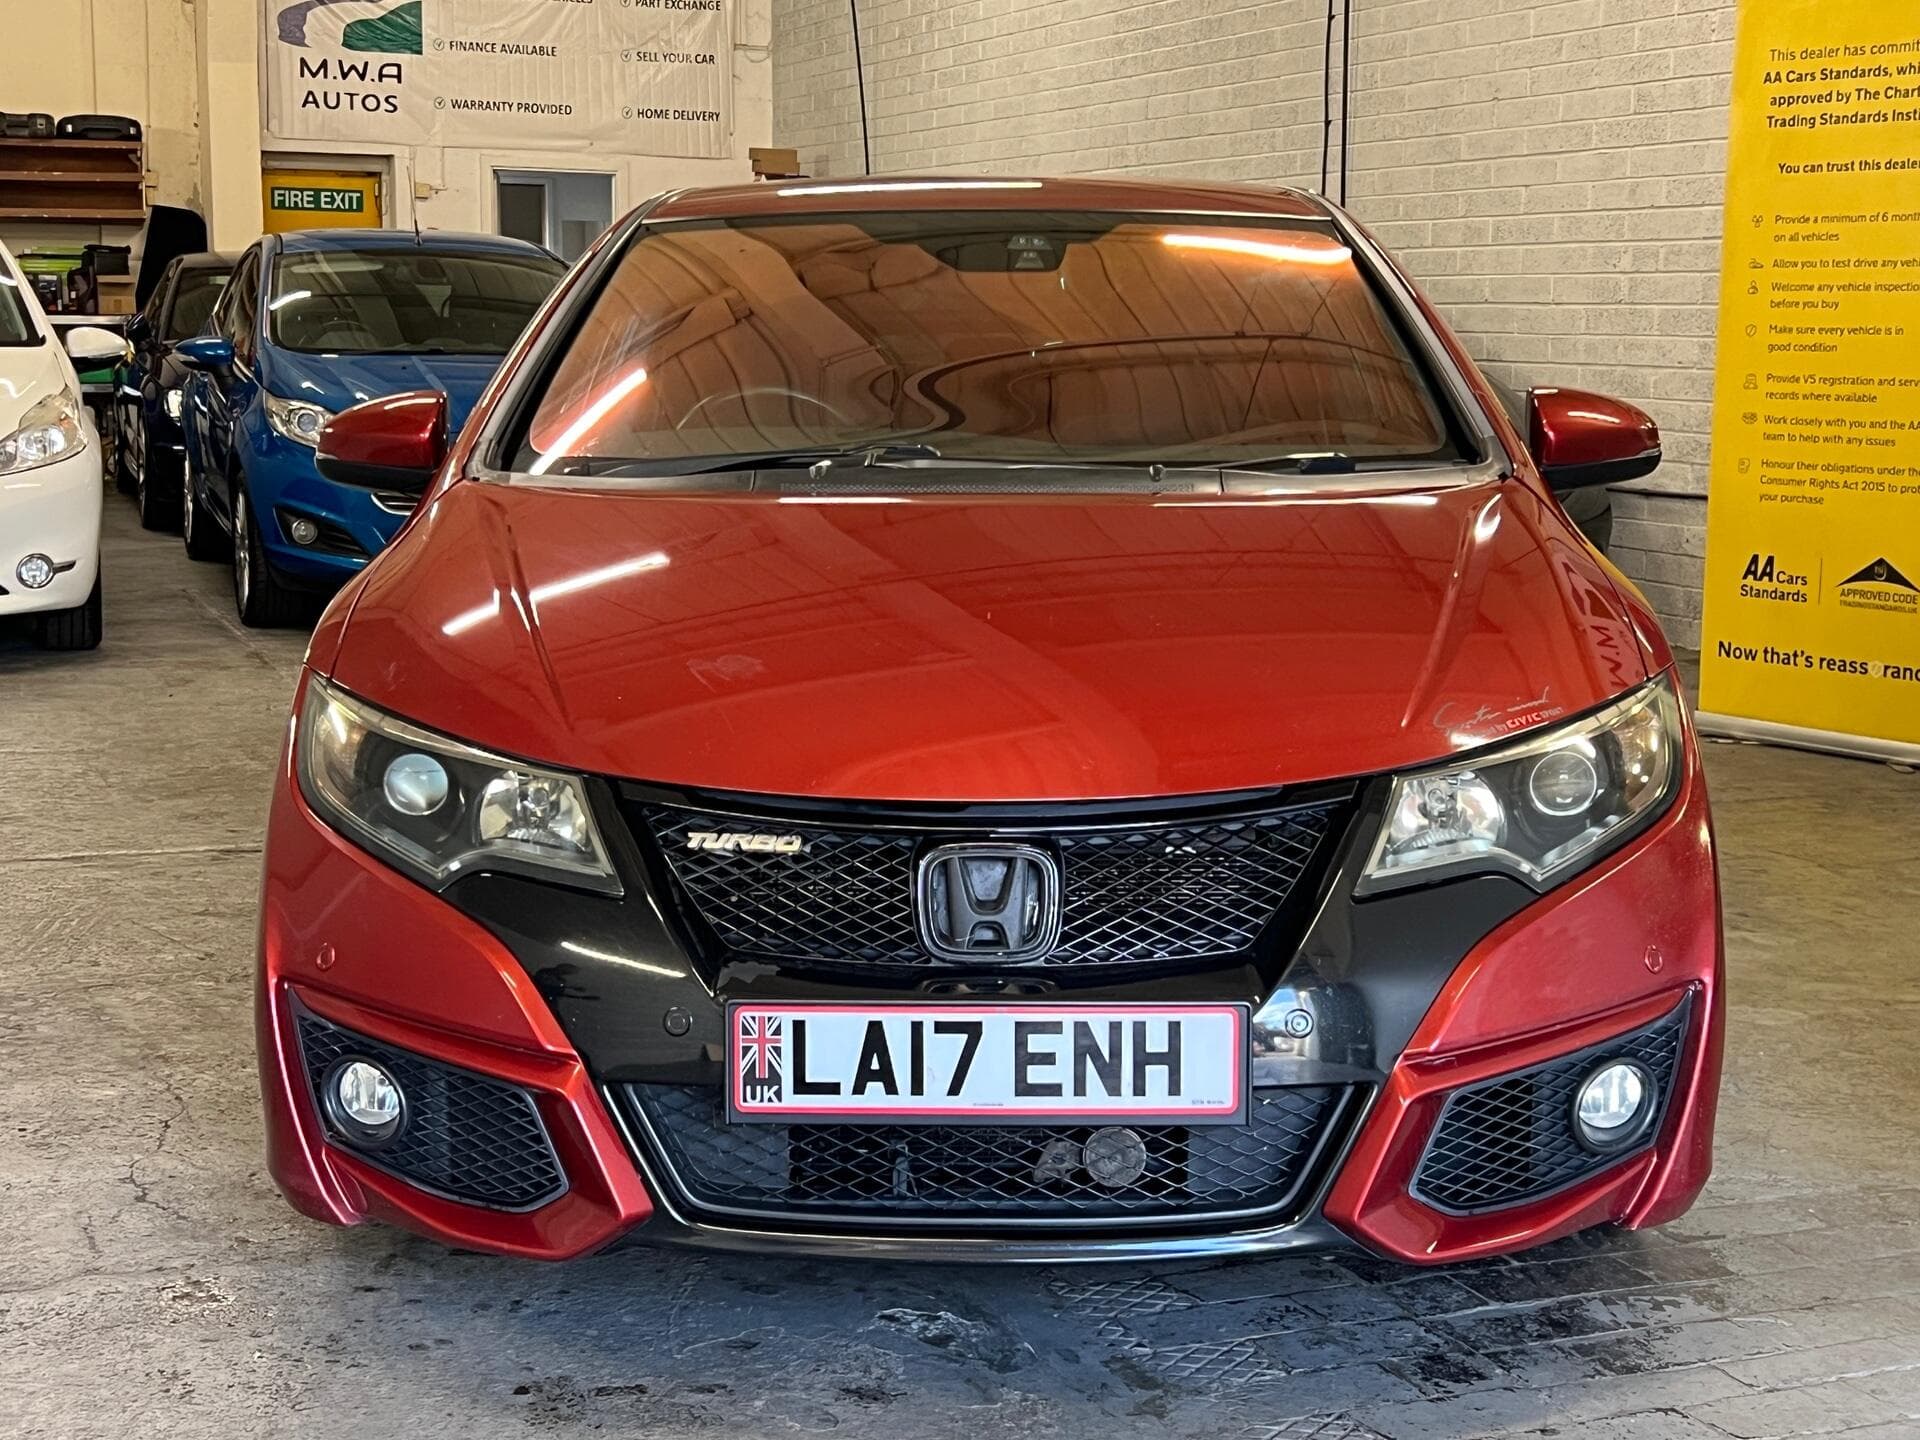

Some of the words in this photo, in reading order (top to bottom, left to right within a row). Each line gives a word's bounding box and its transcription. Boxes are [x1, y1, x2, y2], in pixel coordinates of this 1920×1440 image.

[664, 0, 721, 11] EXCHANGE
[449, 40, 497, 53] FINANCE
[500, 43, 557, 57] AVAILABLE
[1770, 48, 1796, 62] This
[1800, 45, 1840, 60] dealer
[1843, 44, 1866, 57] has
[636, 51, 660, 63] SELL
[662, 53, 693, 63] YOUR
[695, 54, 716, 65] CAR
[299, 57, 402, 84] M.W.A
[1763, 71, 1782, 85] AA
[1786, 70, 1816, 83] Cars
[1820, 64, 1893, 81] Standards,
[301, 90, 398, 113] AUTOS
[1770, 90, 1833, 108] approved
[1836, 90, 1852, 104] by
[1855, 88, 1881, 101] The
[450, 99, 514, 114] WARRANTY
[516, 102, 572, 116] PROVIDED
[636, 108, 670, 120] HOME
[673, 110, 721, 122] DELIVERY
[1767, 114, 1816, 129] Trading
[1819, 110, 1889, 126] Standards
[1778, 162, 1800, 175] You
[1803, 163, 1823, 173] can
[1826, 160, 1855, 172] trust
[1859, 159, 1881, 171] this
[273, 189, 315, 208] FIRE
[320, 191, 361, 209] EXIT
[1774, 214, 1810, 225] Provide
[1812, 216, 1818, 224] a
[1821, 213, 1866, 223] minimum
[1869, 212, 1881, 222] of
[1881, 212, 1889, 222] 6
[1774, 234, 1786, 242] on
[1788, 232, 1799, 242] all
[1801, 232, 1840, 242] vehicles
[1772, 258, 1800, 268] Allow
[1801, 261, 1817, 270] you
[1820, 259, 1830, 268] to
[1831, 258, 1850, 268] test
[1853, 258, 1878, 268] drive
[1881, 260, 1898, 269] any
[1771, 282, 1814, 292] Welcome
[1817, 284, 1833, 293] any
[1836, 282, 1871, 292] vehicle
[1770, 299, 1800, 309] before
[1802, 301, 1819, 310] you
[1821, 299, 1839, 310] buy
[1768, 324, 1793, 334] Make
[1796, 326, 1815, 334] sure
[1818, 327, 1845, 337] every
[1847, 325, 1882, 335] vehicle
[1884, 326, 1892, 335] is
[1895, 326, 1904, 335] in
[1767, 343, 1791, 353] good
[1793, 342, 1838, 352] condition
[1766, 373, 1801, 384] Provide
[1803, 374, 1816, 384] V5
[1818, 375, 1875, 387] registration
[1877, 377, 1896, 387] and
[1765, 390, 1799, 400] records
[1802, 391, 1832, 401] where
[1834, 392, 1877, 403] available
[1764, 415, 1787, 425] Work
[1789, 416, 1823, 428] closely
[1825, 417, 1846, 427] with
[1849, 420, 1866, 430] you
[1869, 420, 1887, 430] and
[1890, 420, 1905, 430] the
[1763, 431, 1785, 441] team
[1787, 432, 1797, 442] to
[1799, 432, 1820, 444] help
[1823, 433, 1843, 444] with
[1846, 437, 1863, 447] any
[1866, 436, 1896, 447] issues
[1761, 458, 1794, 469] Honour
[1796, 461, 1820, 471] their
[1821, 462, 1874, 475] obligations
[1877, 465, 1905, 476] under
[1760, 475, 1806, 486] Consumer
[1809, 478, 1840, 490] Rights
[1842, 480, 1858, 490] Act
[1861, 481, 1885, 492] 2015
[1888, 483, 1898, 493] to
[1759, 493, 1778, 502] your
[1781, 494, 1824, 505] purchase
[1742, 554, 1775, 582] AA
[1776, 571, 1808, 586] Cars
[1740, 584, 1808, 603] Standards
[1840, 588, 1891, 603] APPROVED
[1892, 593, 1919, 605] CODE
[1718, 640, 1758, 661] Now
[1763, 646, 1814, 668] that's
[1505, 711, 1542, 730] CIVIC
[687, 832, 802, 855] TURBO
[792, 1020, 983, 1097] LA17
[1014, 1020, 1182, 1097] ENH
[745, 1084, 780, 1103] UK
